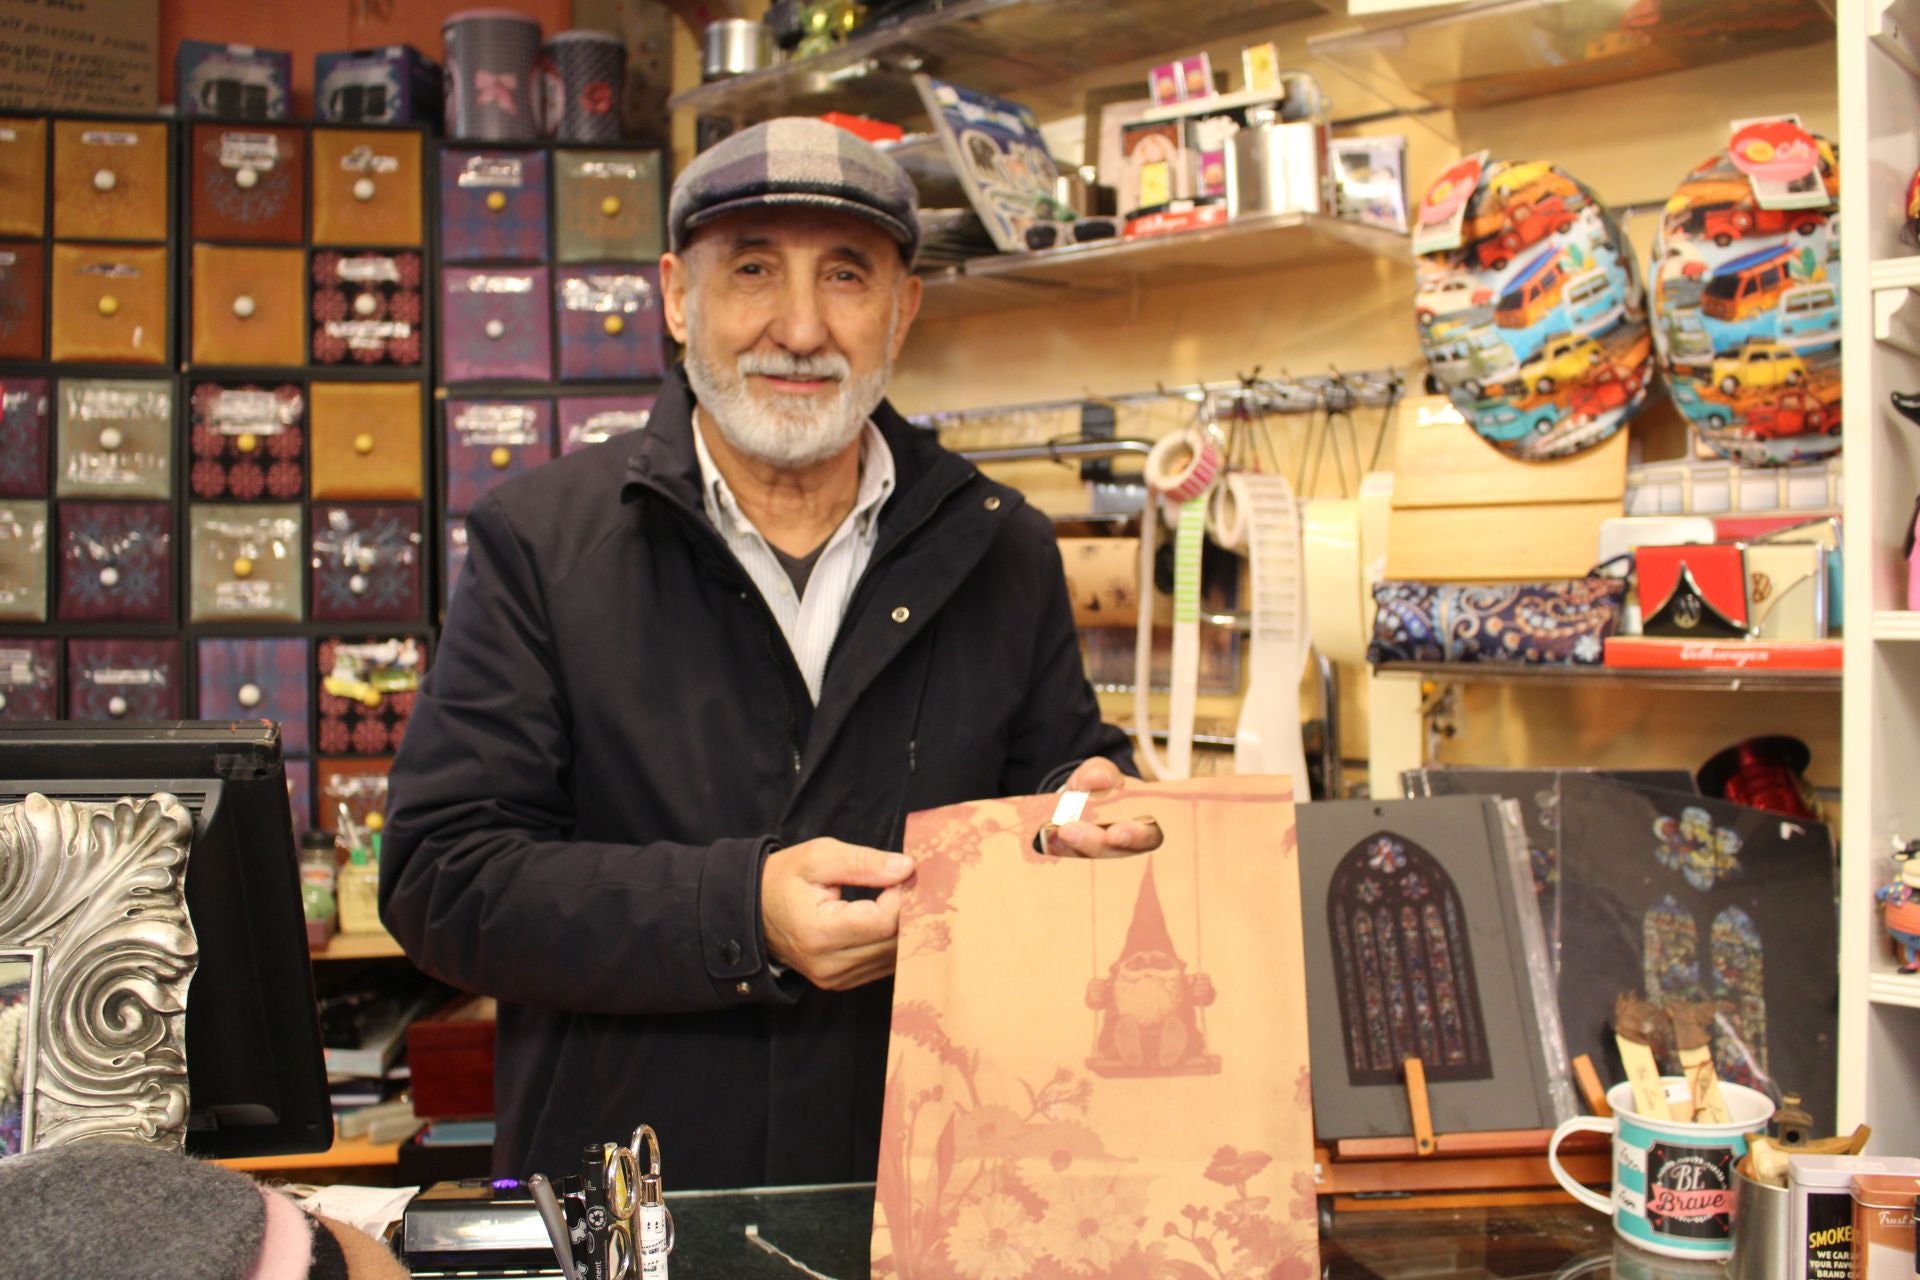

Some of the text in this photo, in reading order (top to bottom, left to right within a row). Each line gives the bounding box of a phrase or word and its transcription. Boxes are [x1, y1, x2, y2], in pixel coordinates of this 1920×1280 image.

[1671, 1163, 1705, 1190] BE
[1656, 1191, 1726, 1212] Brave
[1878, 1211, 1907, 1225] Trust
[1817, 1251, 1852, 1260] WE CAR
[594, 1261, 602, 1280] nent
[1809, 1260, 1833, 1269] YOUR
[1817, 1270, 1846, 1279] BRAND
